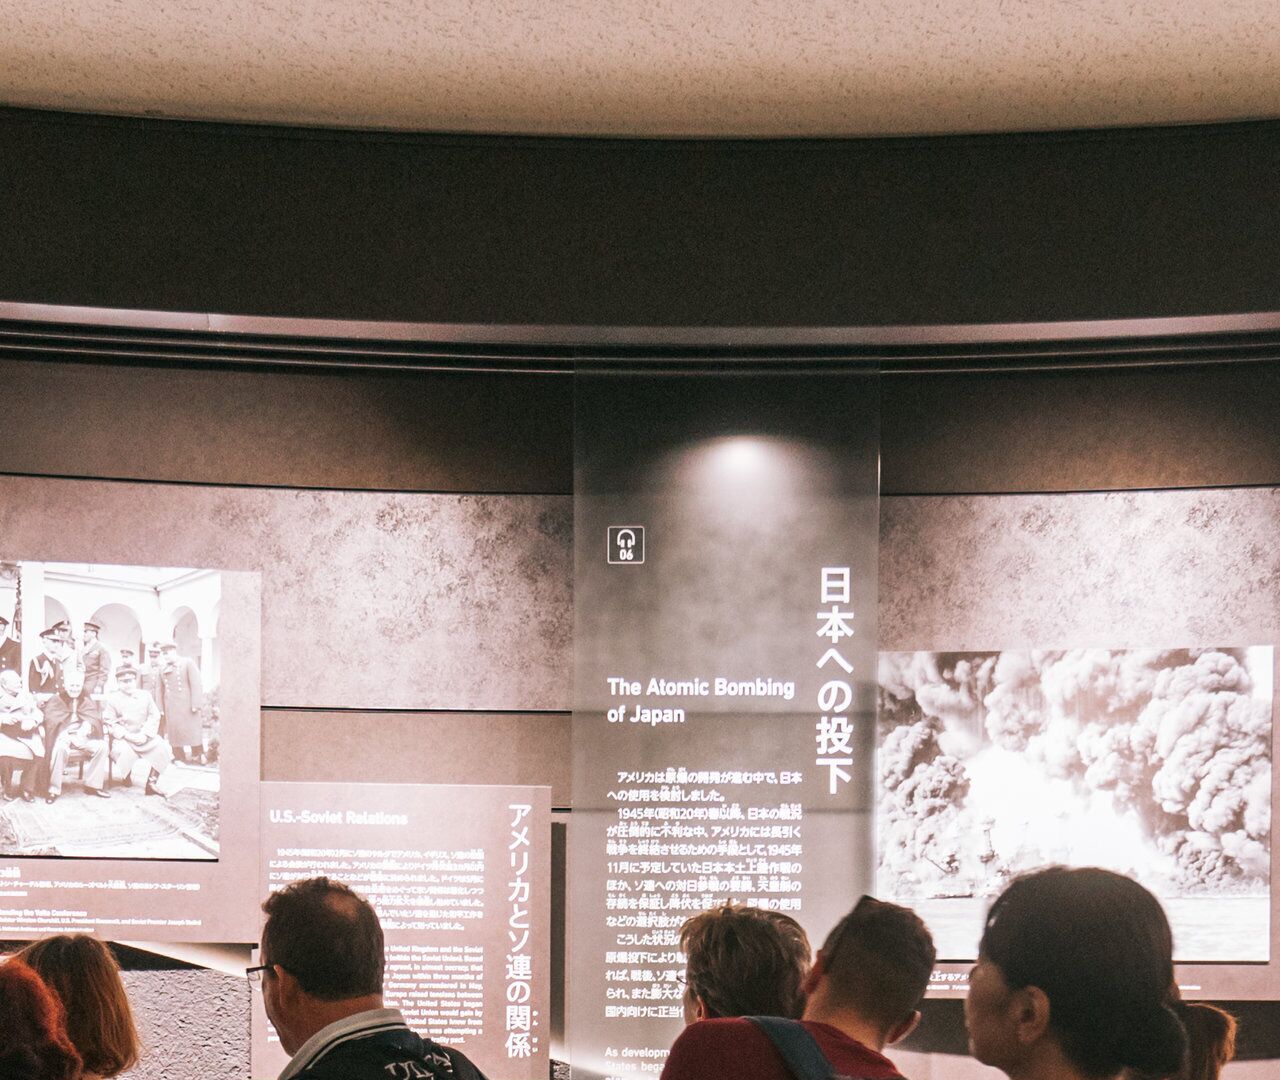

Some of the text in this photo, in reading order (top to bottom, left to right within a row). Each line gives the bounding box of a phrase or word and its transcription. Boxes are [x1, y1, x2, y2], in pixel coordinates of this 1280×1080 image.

[619, 549, 634, 561] 06
[607, 678, 795, 699] The Atomic Bombing
[816, 568, 854, 794] 日本への投下
[607, 704, 684, 724] of Japan
[270, 809, 408, 825] U.S.-Soviet Relations
[506, 805, 531, 1057] アメリカとソ連の関係
